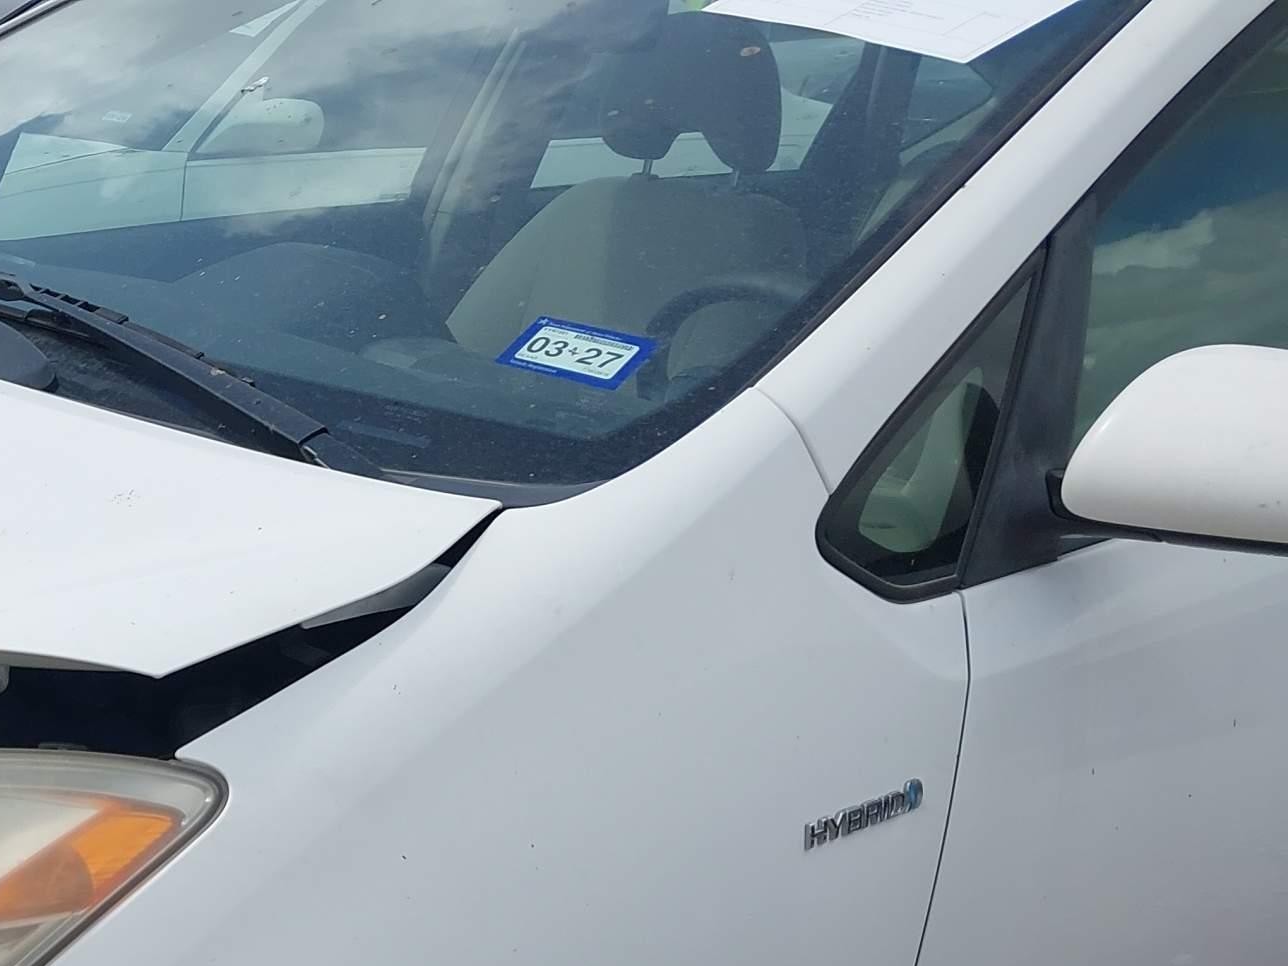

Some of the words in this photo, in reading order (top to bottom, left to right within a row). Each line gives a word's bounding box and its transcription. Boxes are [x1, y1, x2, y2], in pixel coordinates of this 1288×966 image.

[526, 336, 569, 358] 03
[576, 347, 625, 369] 27
[804, 790, 910, 851] HYBRID
